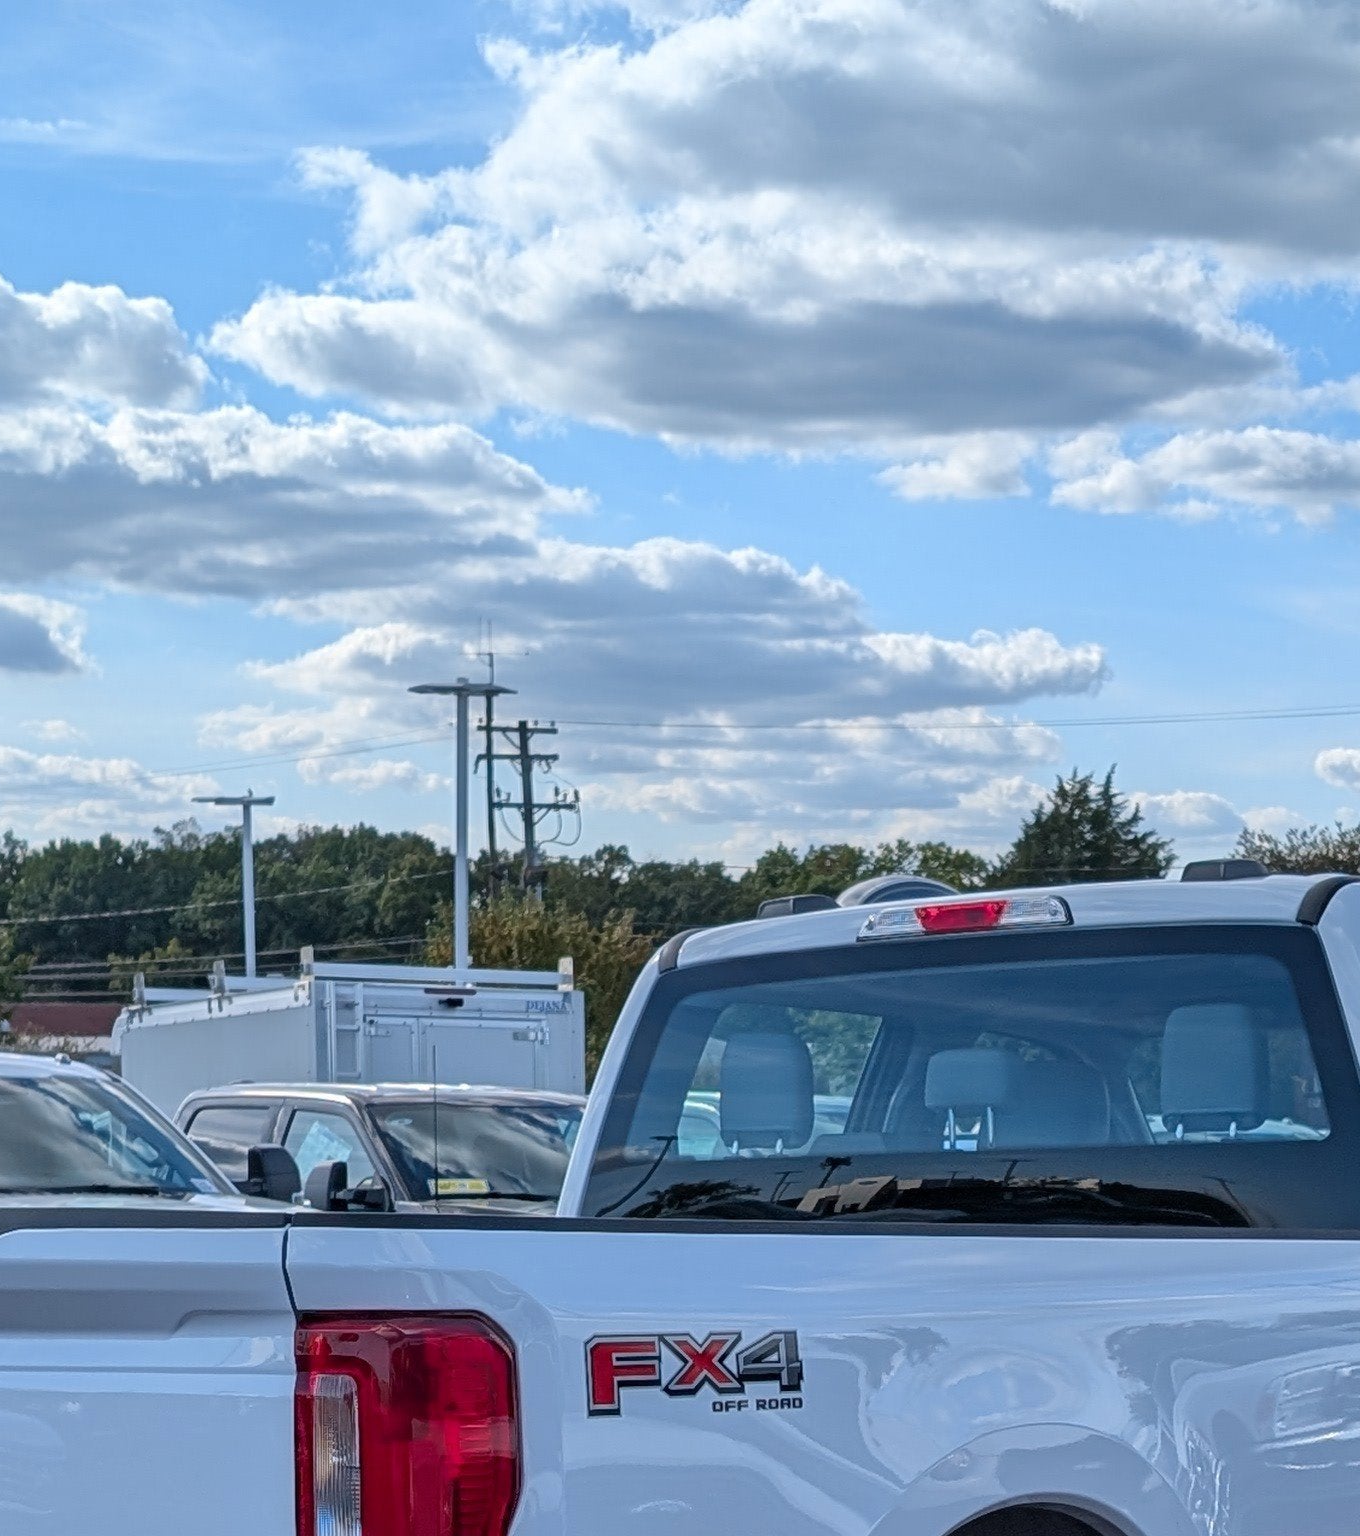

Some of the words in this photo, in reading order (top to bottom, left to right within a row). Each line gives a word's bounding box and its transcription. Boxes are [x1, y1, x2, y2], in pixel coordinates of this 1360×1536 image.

[585, 1330, 804, 1418] FX4
[712, 1399, 749, 1413] OFF
[756, 1397, 803, 1411] ROAD
